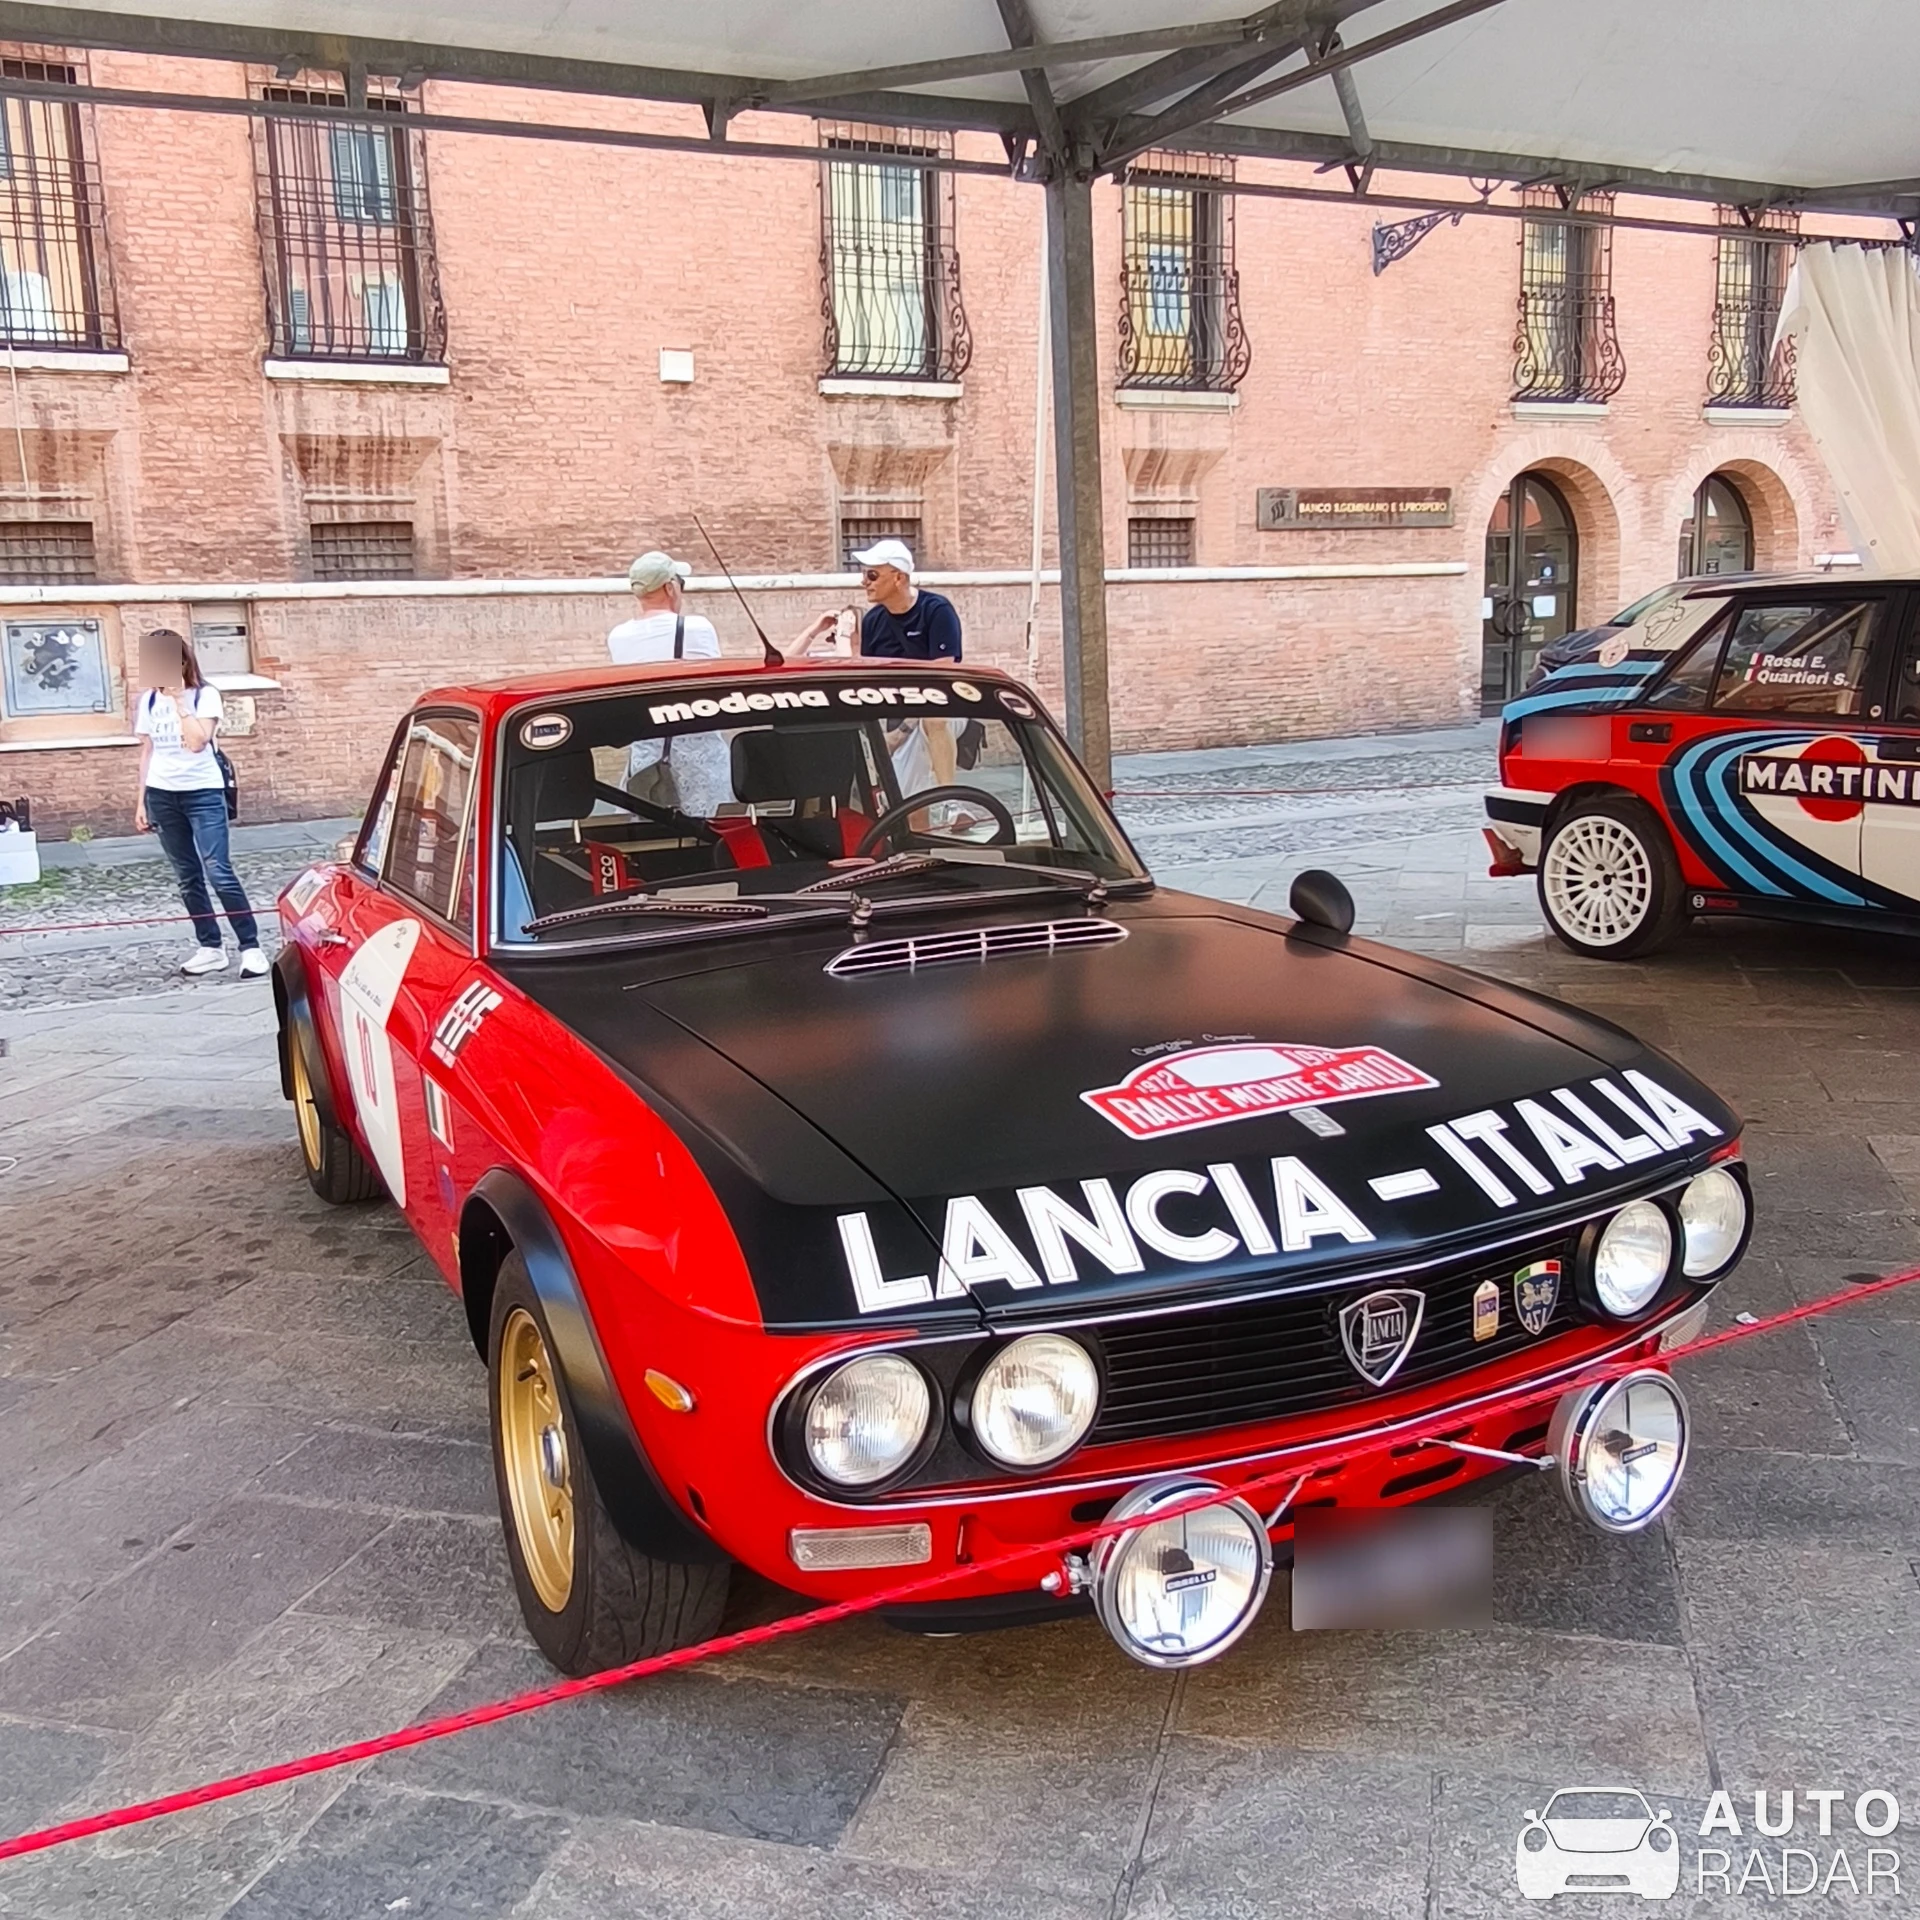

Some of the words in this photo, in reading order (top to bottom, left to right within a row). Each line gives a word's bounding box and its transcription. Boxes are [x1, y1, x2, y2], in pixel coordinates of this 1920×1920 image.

[1762, 654, 1808, 668] Rossi
[1810, 656, 1826, 669] E.
[1757, 669, 1830, 685] Quartieri
[1833, 672, 1850, 687] S.
[649, 691, 830, 724] modena
[839, 687, 949, 705] corse
[1134, 1069, 1188, 1094] 1972
[1107, 1090, 1232, 1130] RALLYE
[837, 1156, 1377, 1314] LANCIA
[1425, 1069, 1724, 1207] ITALIA
